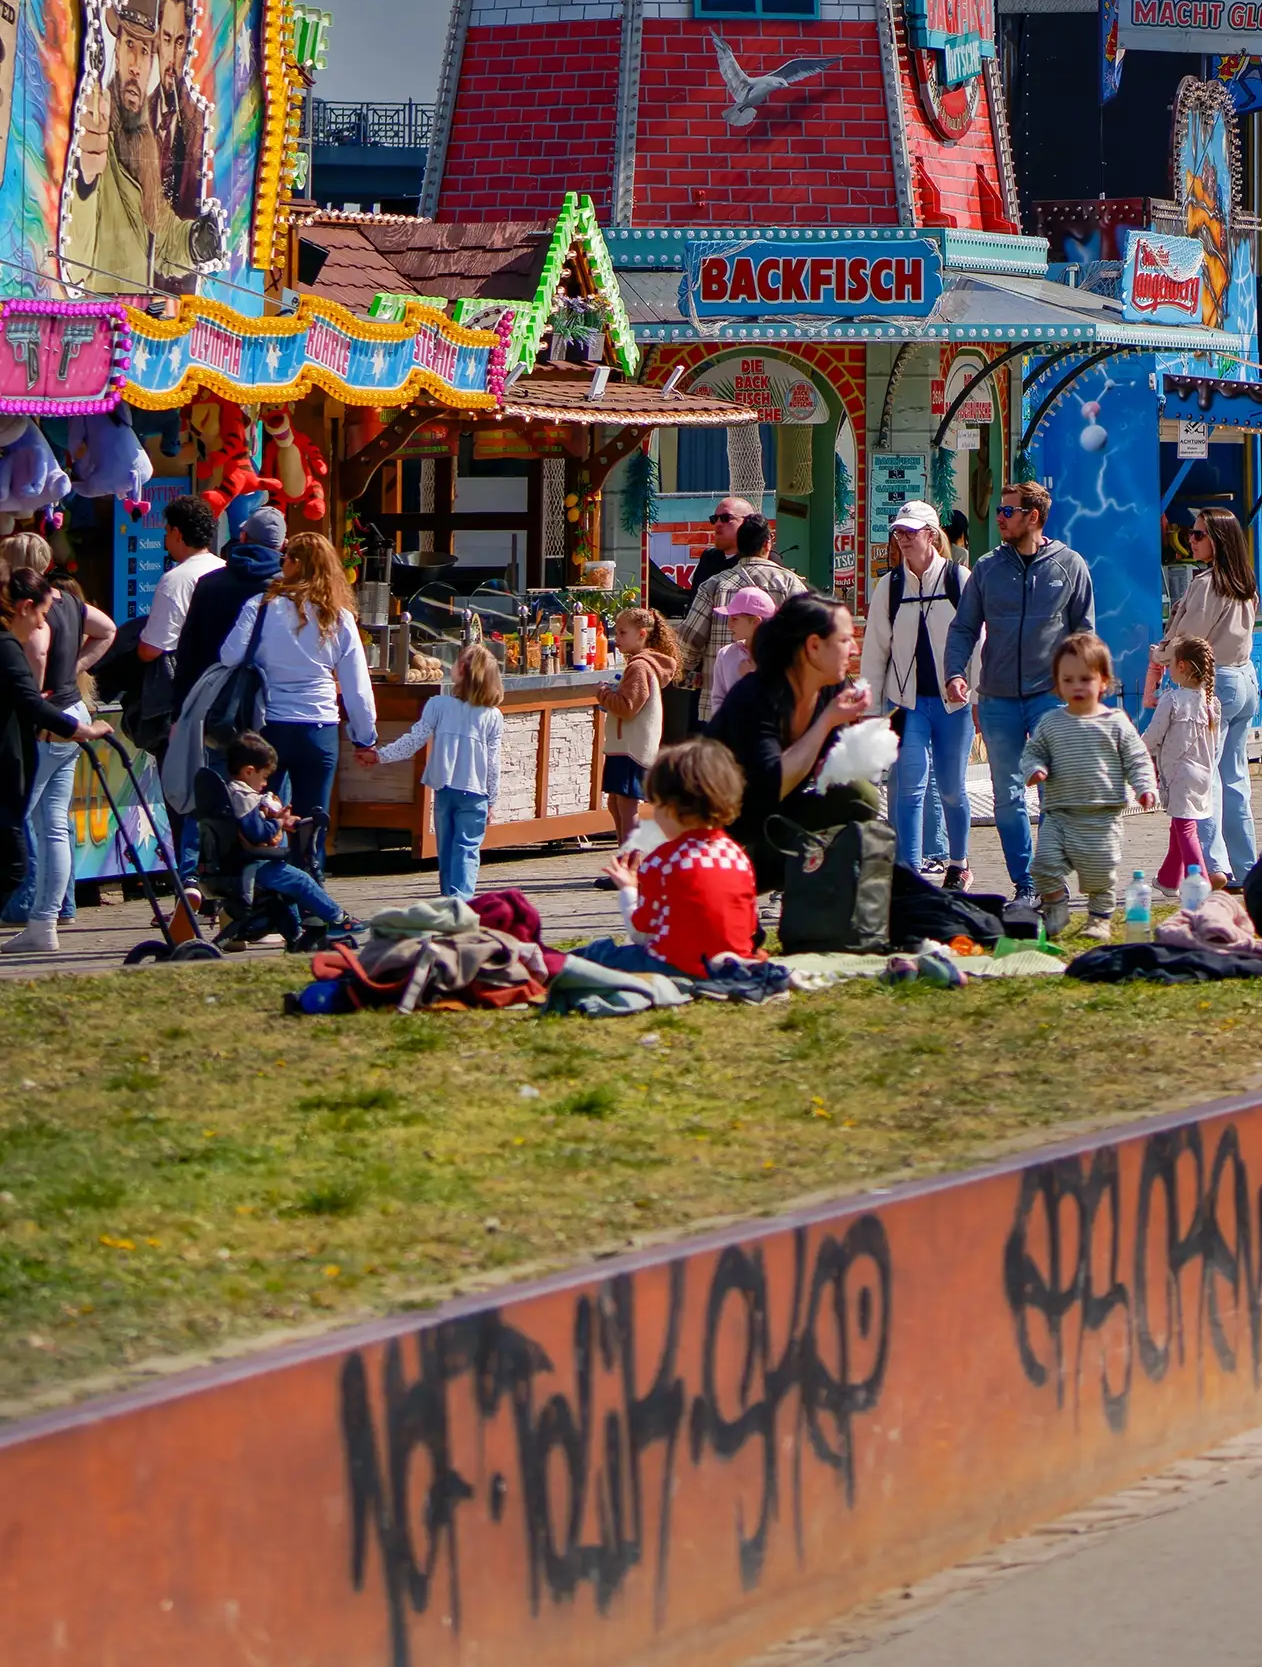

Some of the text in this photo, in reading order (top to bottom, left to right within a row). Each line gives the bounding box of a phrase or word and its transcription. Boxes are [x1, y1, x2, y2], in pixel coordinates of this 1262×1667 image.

[945, 41, 982, 82] RUTSCHE
[701, 257, 924, 303] BACKFISCH
[189, 320, 242, 377] OLYMPIA
[741, 359, 764, 373] DIE
[735, 375, 769, 389] BACK
[735, 391, 771, 406] FISCH
